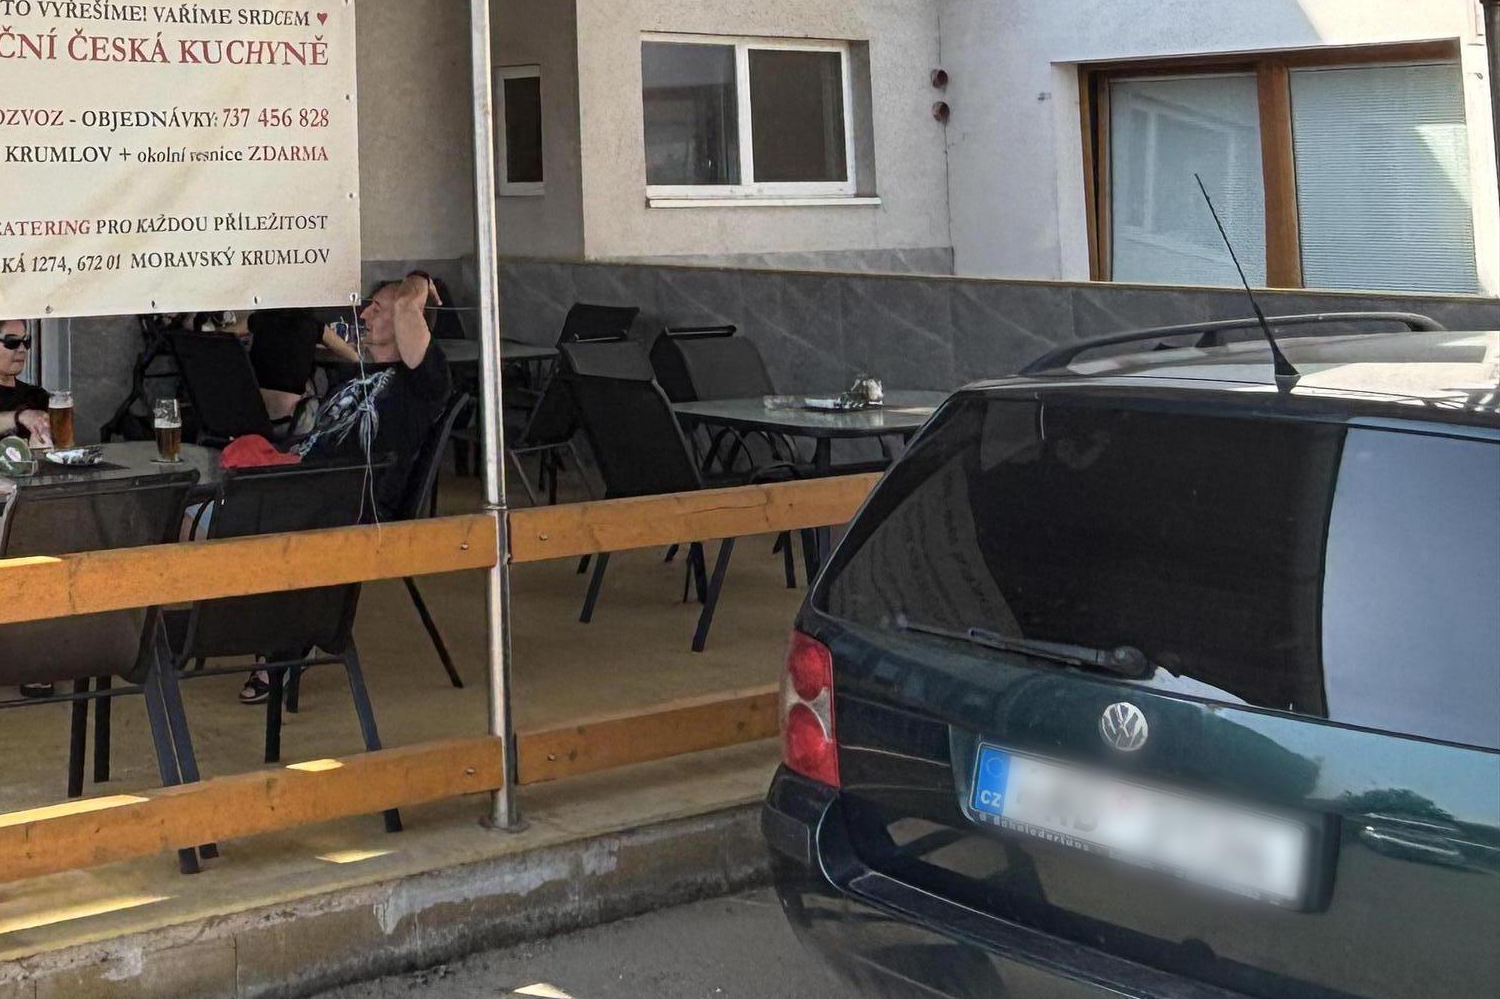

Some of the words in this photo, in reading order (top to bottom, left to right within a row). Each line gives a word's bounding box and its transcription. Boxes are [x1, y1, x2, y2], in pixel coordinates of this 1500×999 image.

[0, 0, 32, 17] TO
[153, 3, 233, 26] VAŘÍME
[238, 8, 311, 27] SRDCEM
[67, 27, 171, 64] ČESKÁ
[177, 33, 330, 67] KUCHYNĚ
[81, 107, 219, 132] OBJEDNÁVKY:
[222, 107, 251, 128] 737
[257, 108, 293, 128] 456
[299, 107, 330, 128] 828
[4, 145, 113, 163] KRUMLOV
[137, 145, 186, 164] okolní
[247, 145, 330, 162] ZDARMA
[96, 218, 132, 235] PRO
[136, 213, 209, 234] KAŽDOU
[213, 212, 329, 231] PŘÍLEŽITOST
[31, 255, 73, 276] 1274,
[76, 254, 103, 272] 672
[130, 246, 237, 269] MORAVSKÝ
[241, 248, 331, 266] KRUMLOV
[980, 789, 1002, 808] CZ
